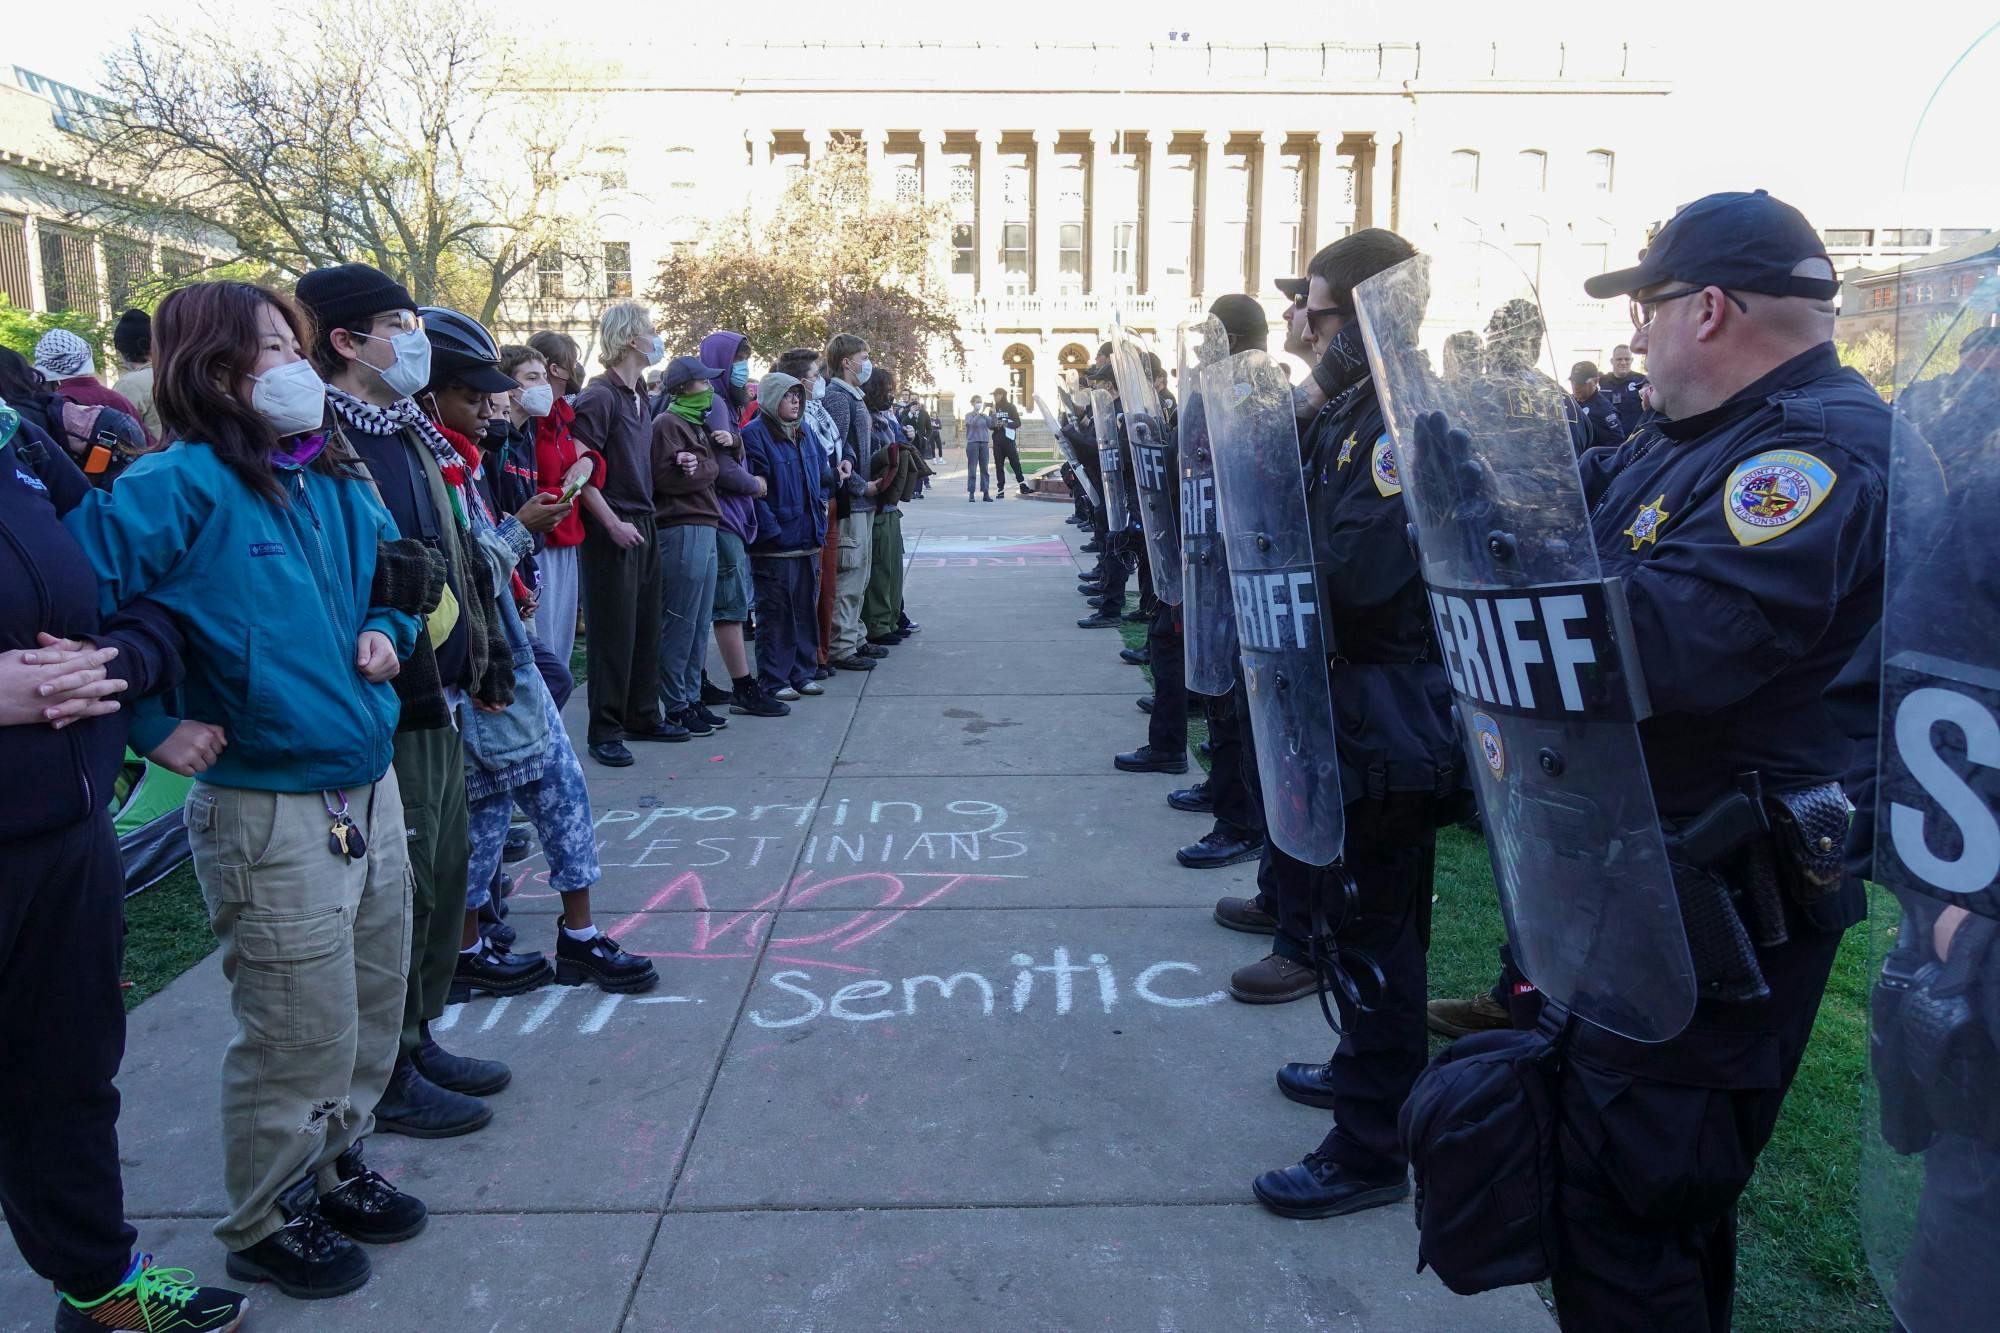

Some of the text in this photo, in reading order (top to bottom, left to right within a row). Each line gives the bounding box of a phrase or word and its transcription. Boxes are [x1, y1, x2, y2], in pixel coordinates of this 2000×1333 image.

[1739, 466, 1809, 497] COUNTY OF DANE
[1758, 454, 1814, 470] SHERIFF
[1734, 504, 1788, 525] WISCONSIN
[1236, 572, 1316, 649] RIFF
[1431, 594, 1596, 711] ERIFF
[592, 798, 1009, 841] pporting
[598, 831, 1029, 870] LESTINIANS
[605, 870, 1002, 950] NOT
